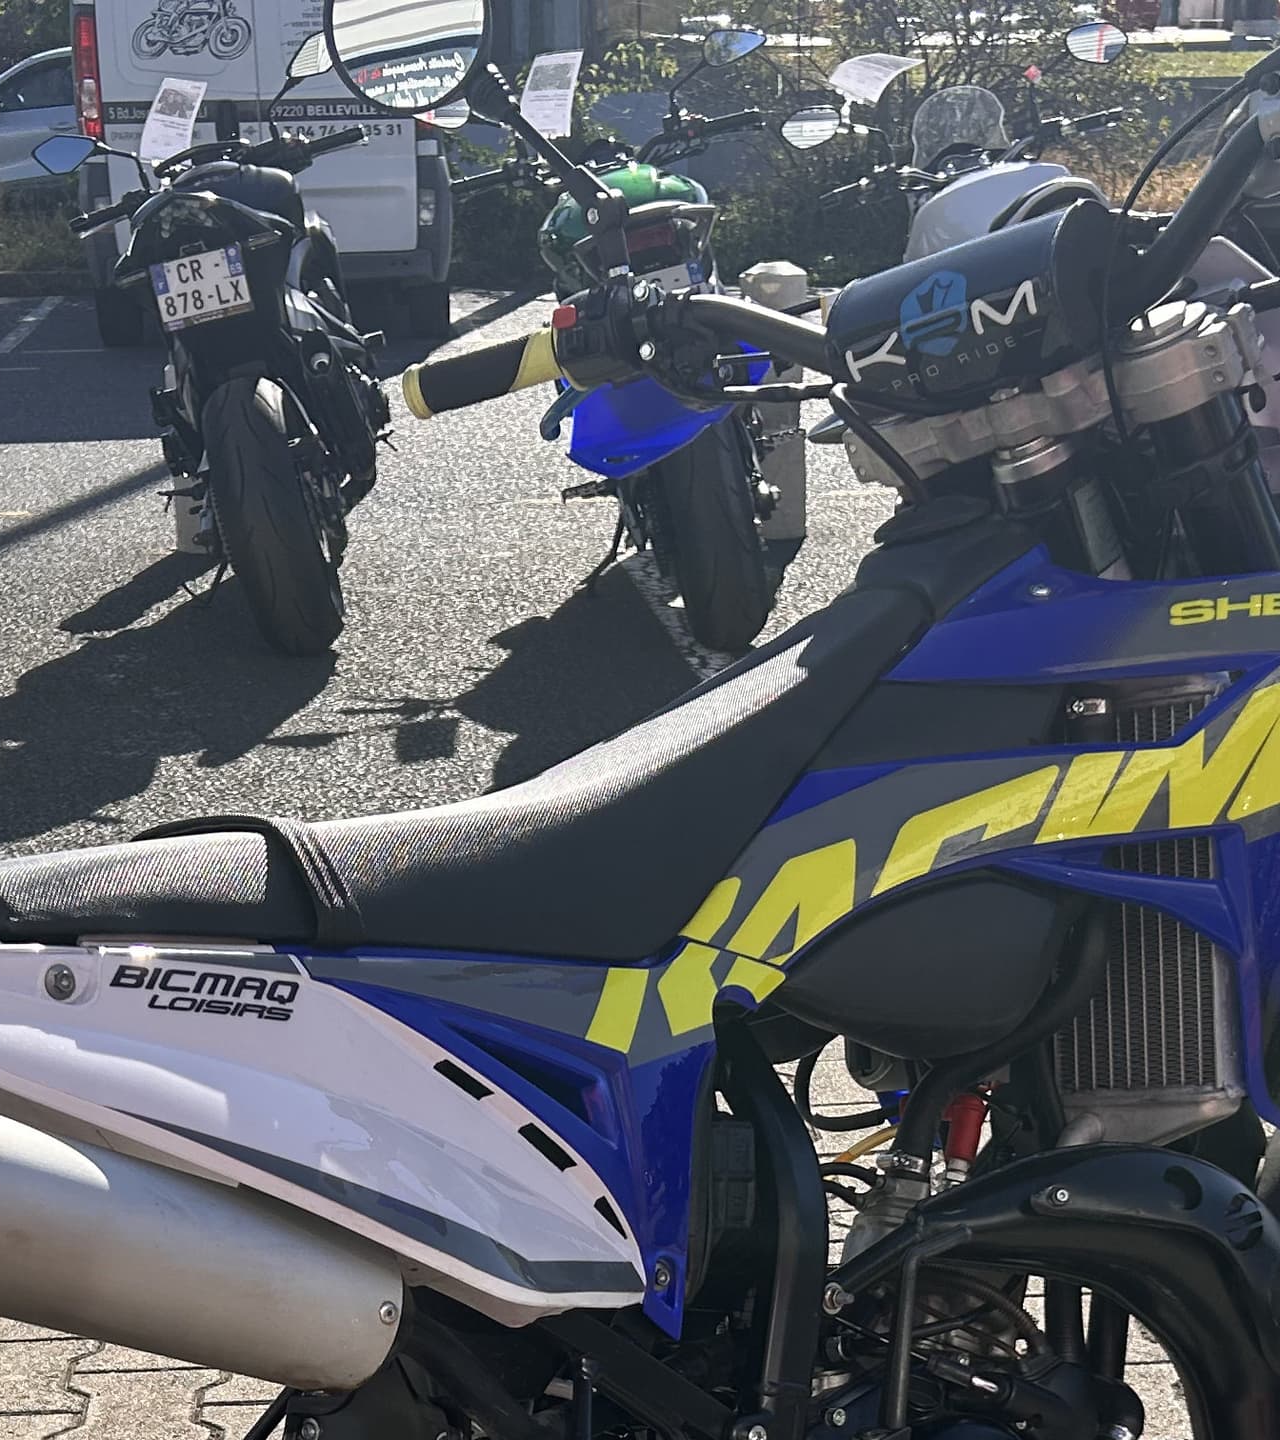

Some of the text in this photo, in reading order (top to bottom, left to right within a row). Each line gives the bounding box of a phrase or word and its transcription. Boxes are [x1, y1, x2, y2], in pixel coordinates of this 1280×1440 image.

[164, 279, 244, 317] 878-LX
[891, 336, 1017, 391] PRO RIDE
[109, 964, 300, 1005] BICMAQ
[147, 994, 294, 1022] LOISIRS
